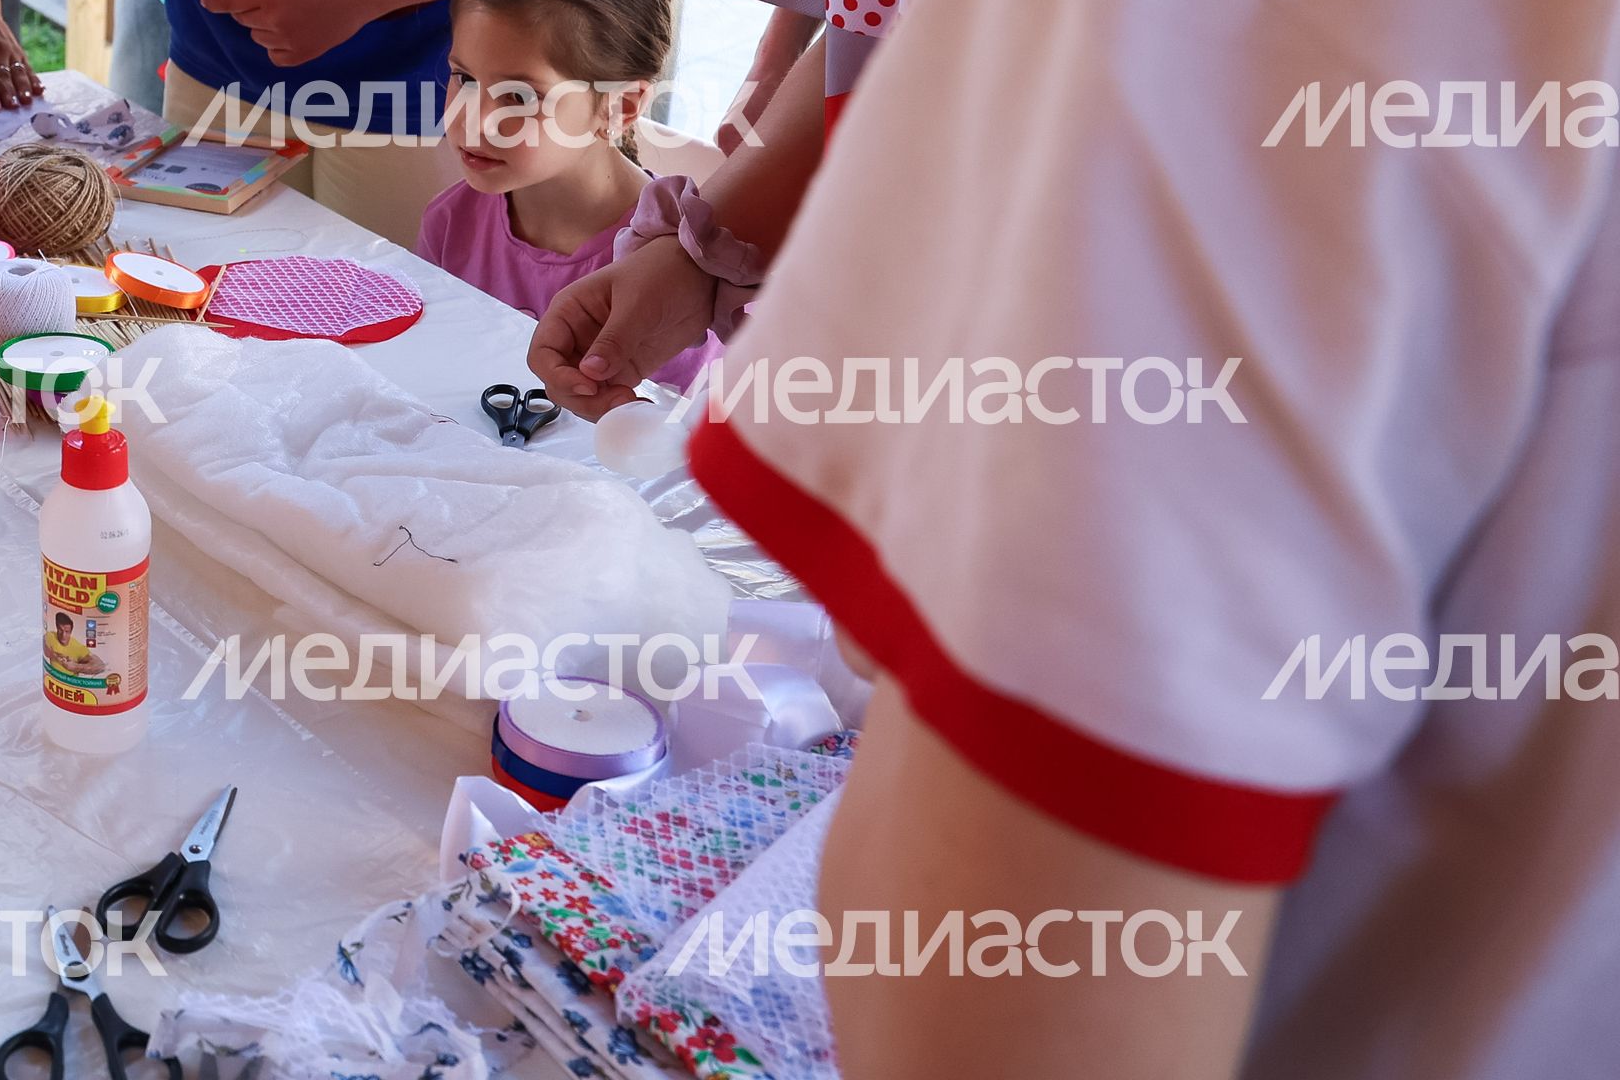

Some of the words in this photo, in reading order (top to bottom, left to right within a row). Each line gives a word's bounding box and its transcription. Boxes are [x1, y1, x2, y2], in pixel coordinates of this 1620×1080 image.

[44, 560, 97, 590] TITAN
[47, 578, 90, 604] WILD
[48, 679, 85, 703] КЛЕЙ
